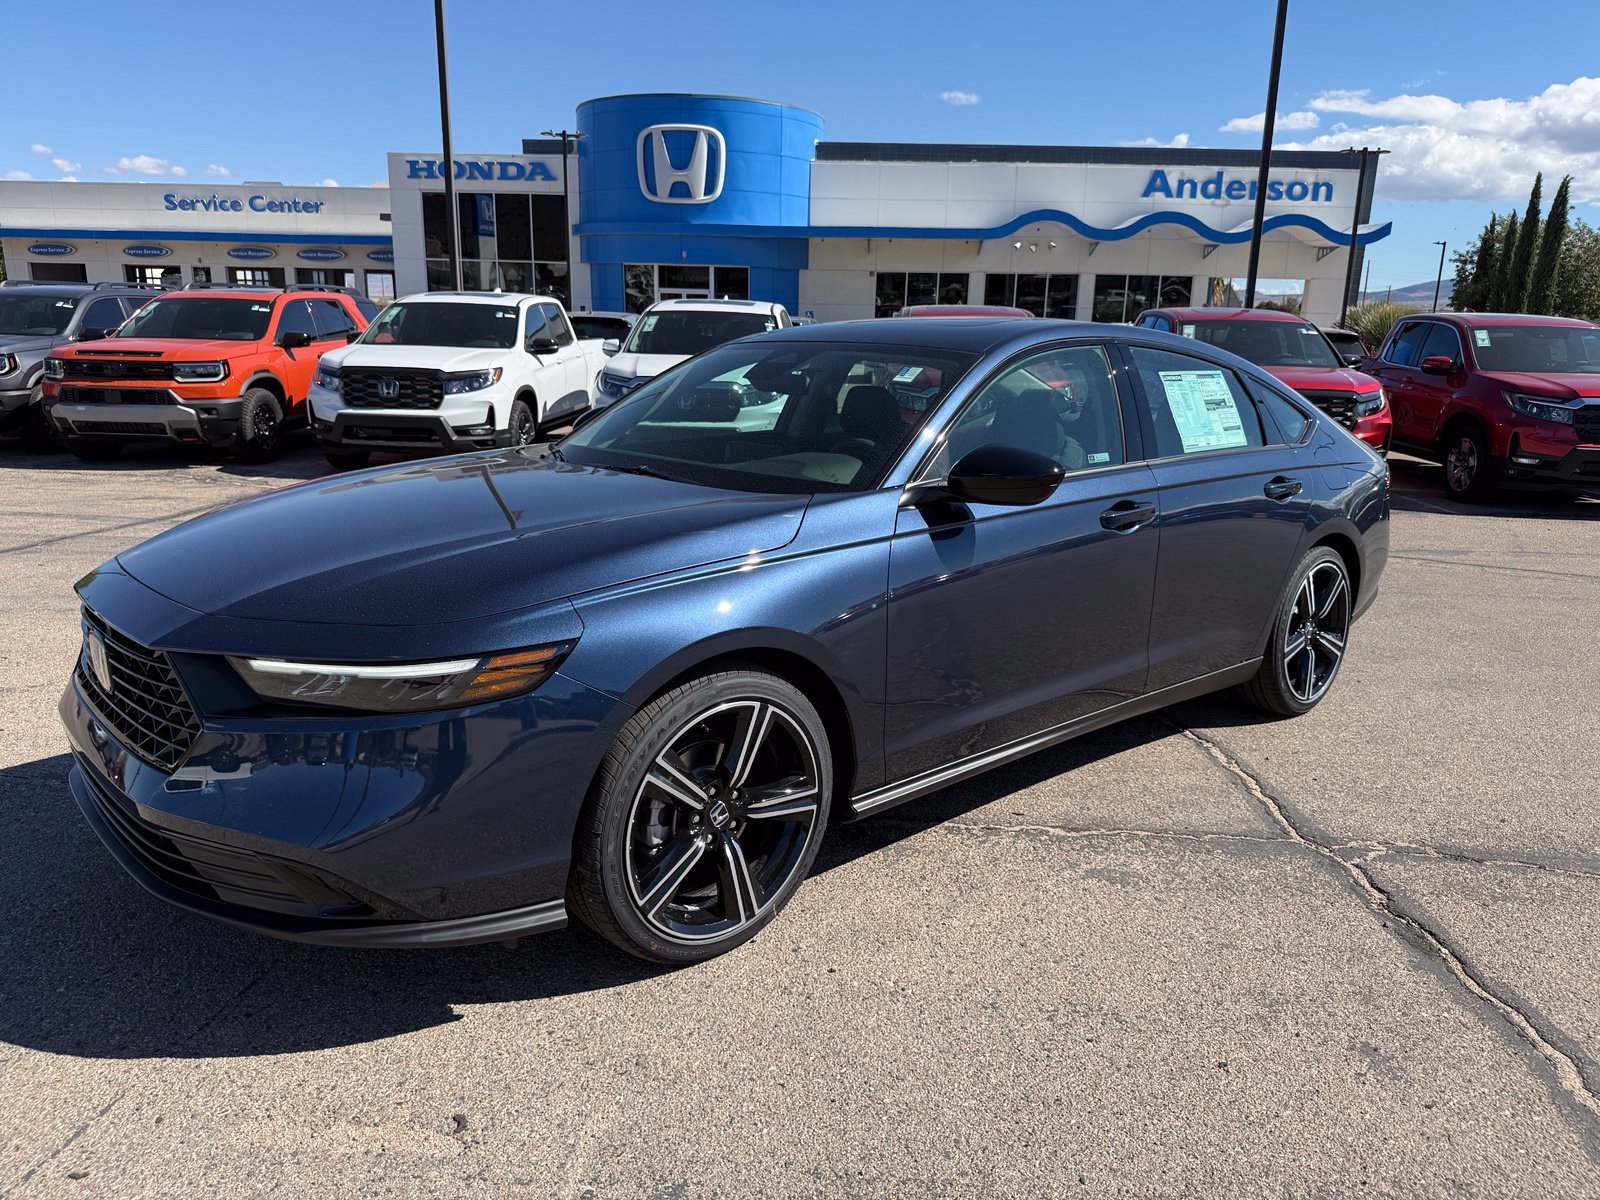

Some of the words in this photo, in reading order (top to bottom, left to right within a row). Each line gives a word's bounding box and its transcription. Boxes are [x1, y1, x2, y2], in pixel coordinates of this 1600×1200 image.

[405, 159, 557, 181] HONDA
[163, 193, 244, 213] Service
[248, 194, 325, 214] Center
